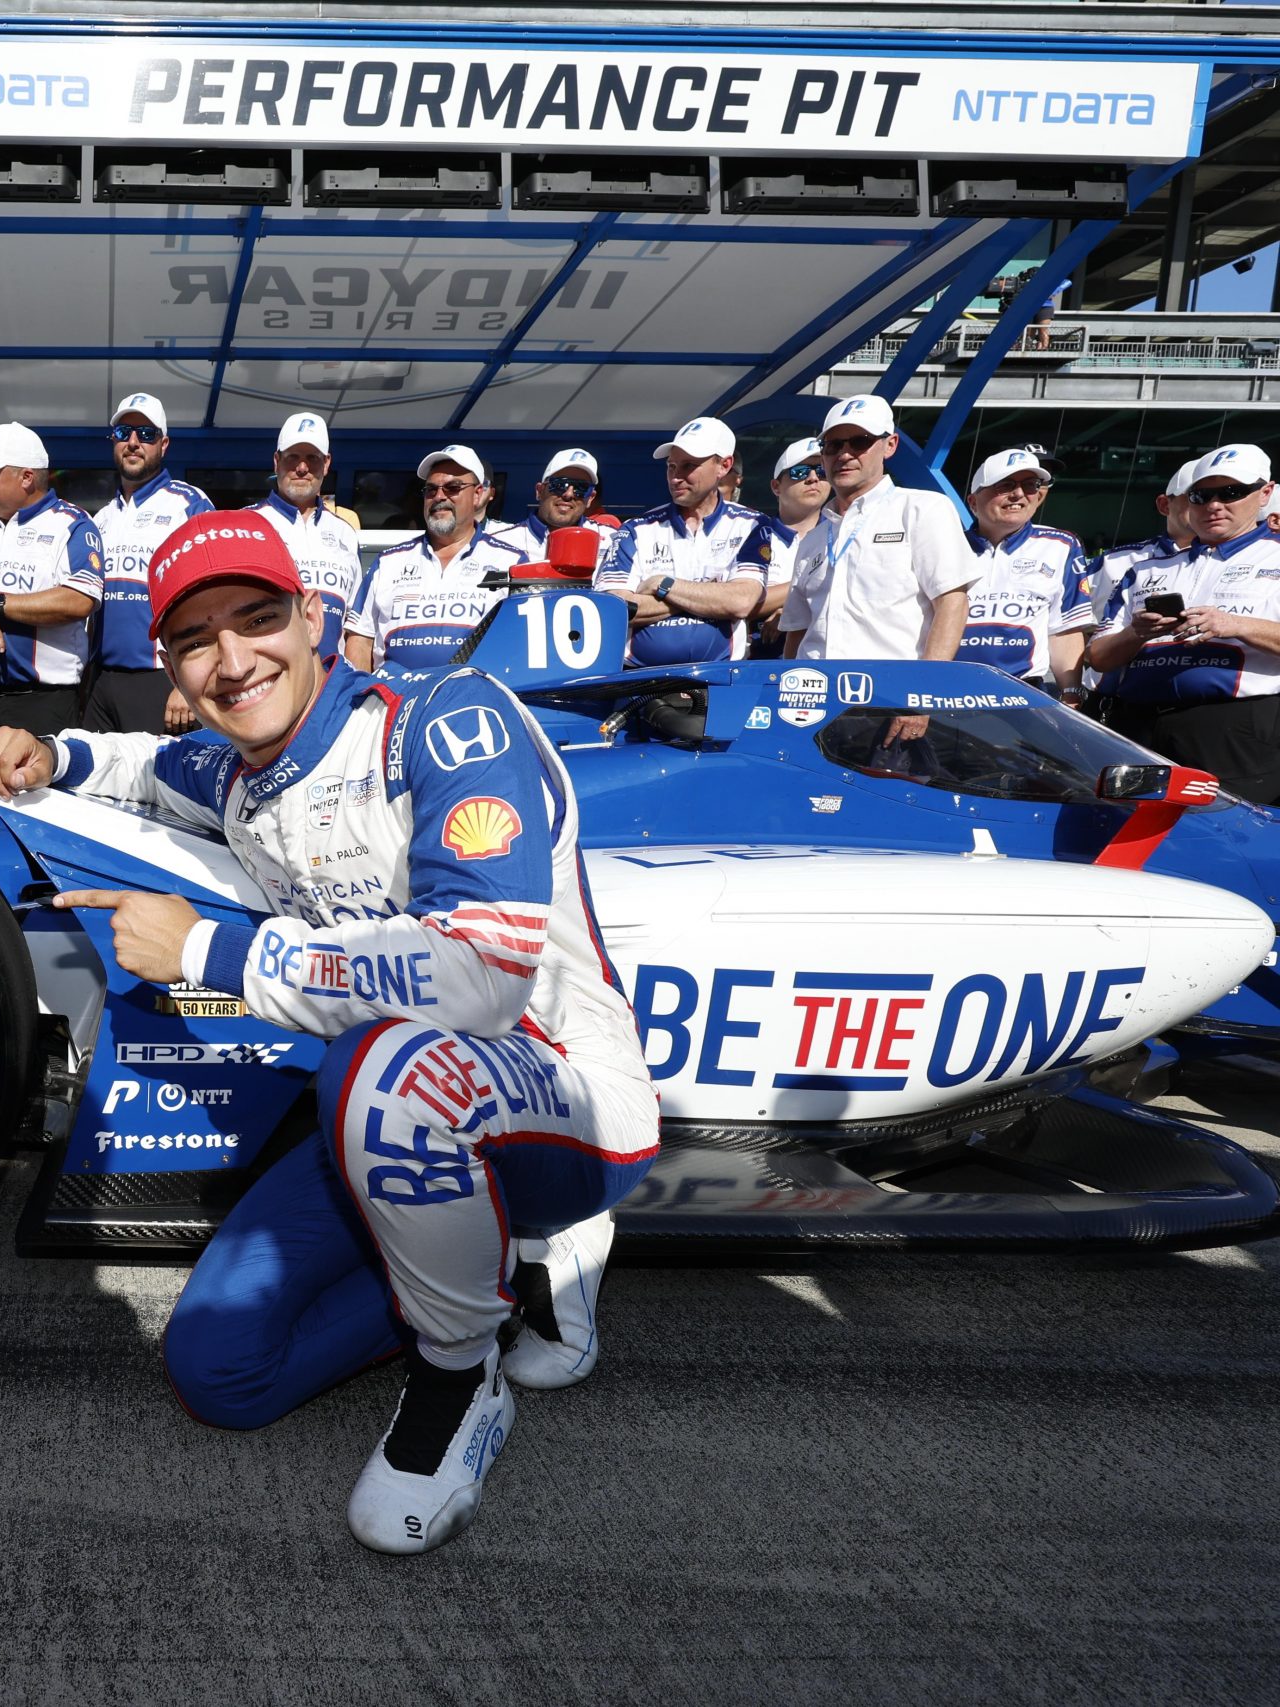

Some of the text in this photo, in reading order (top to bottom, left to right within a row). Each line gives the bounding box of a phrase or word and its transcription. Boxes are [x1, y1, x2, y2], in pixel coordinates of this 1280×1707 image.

[129, 58, 761, 134] PERFORMANCE
[781, 69, 920, 137] PIT
[953, 89, 1038, 123] NTT
[106, 545, 154, 555] MERICAN
[155, 527, 267, 583] Firestone
[104, 556, 149, 572] GION
[299, 569, 350, 592] GION
[420, 592, 487, 602] AMERICAN
[391, 603, 486, 620] LEGION
[517, 595, 602, 669] 10
[802, 679, 824, 688] NTT
[779, 693, 827, 704] INDYCAR
[337, 845, 369, 861] PALOU
[256, 930, 438, 1007] BE THE ONE
[183, 1003, 237, 1015] 50 YEARS
[633, 964, 1147, 1088] BE THE ONE
[119, 1045, 205, 1062] HPD
[190, 1089, 232, 1105] NTT
[94, 1131, 240, 1153] Firestone
[363, 1106, 476, 1206] BE
[462, 1414, 488, 1471] sparco
